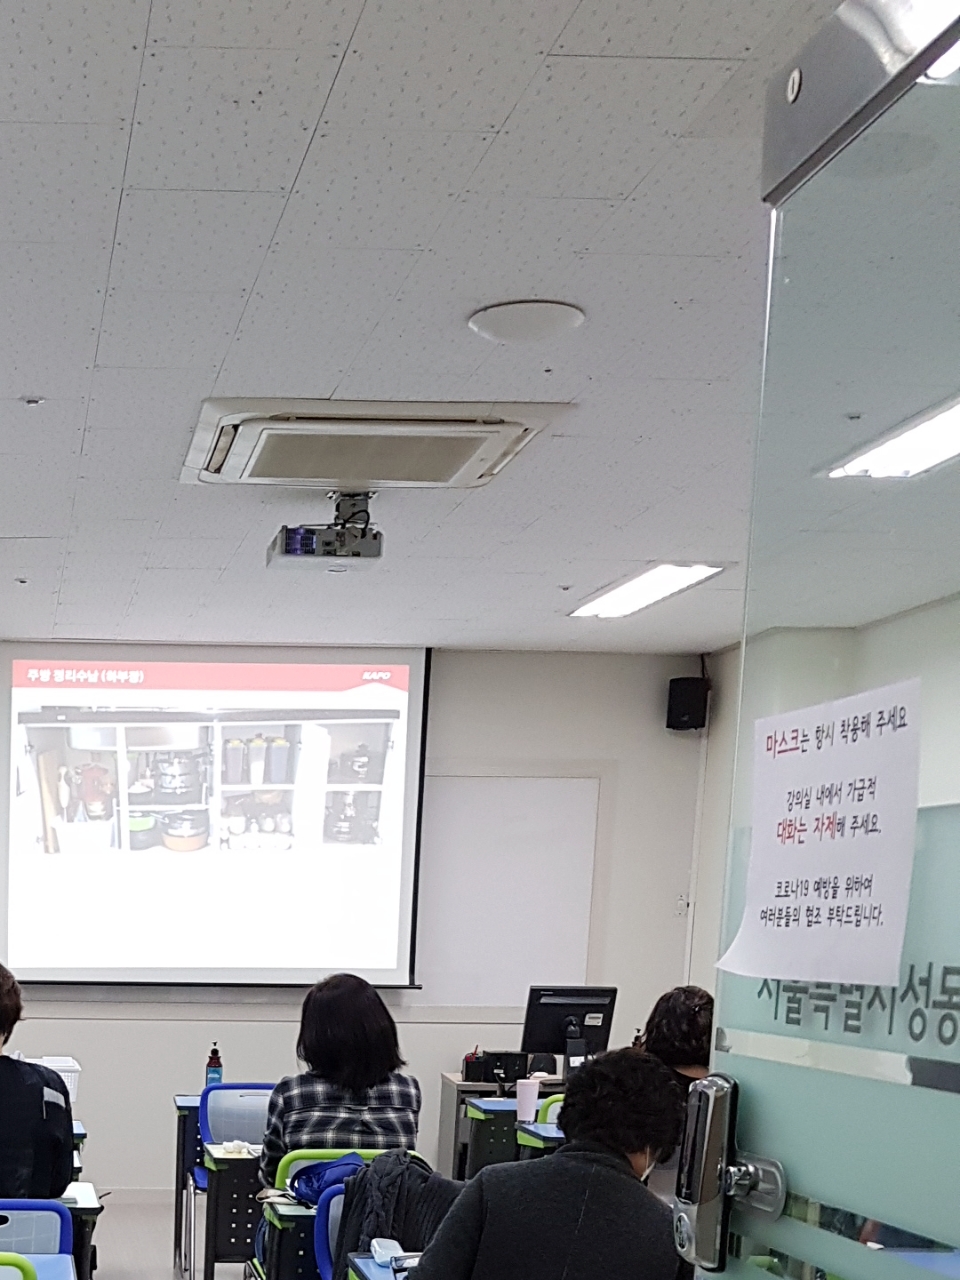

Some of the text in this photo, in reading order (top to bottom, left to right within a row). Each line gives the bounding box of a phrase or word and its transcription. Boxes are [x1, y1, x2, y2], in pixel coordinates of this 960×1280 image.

[27, 668, 51, 682] 주방
[53, 669, 99, 683] 정리수납
[362, 671, 392, 680] KAPO
[766, 705, 907, 759] 마스크는 항시 착용해 주세요
[787, 775, 877, 812] 강의실 내에서 가급적
[776, 811, 882, 845] 대화는 자제해 주세요.
[774, 873, 874, 900] 코로나19 예방을 위하여
[760, 903, 884, 928] 여러분들의 협조 부탁드립니다.
